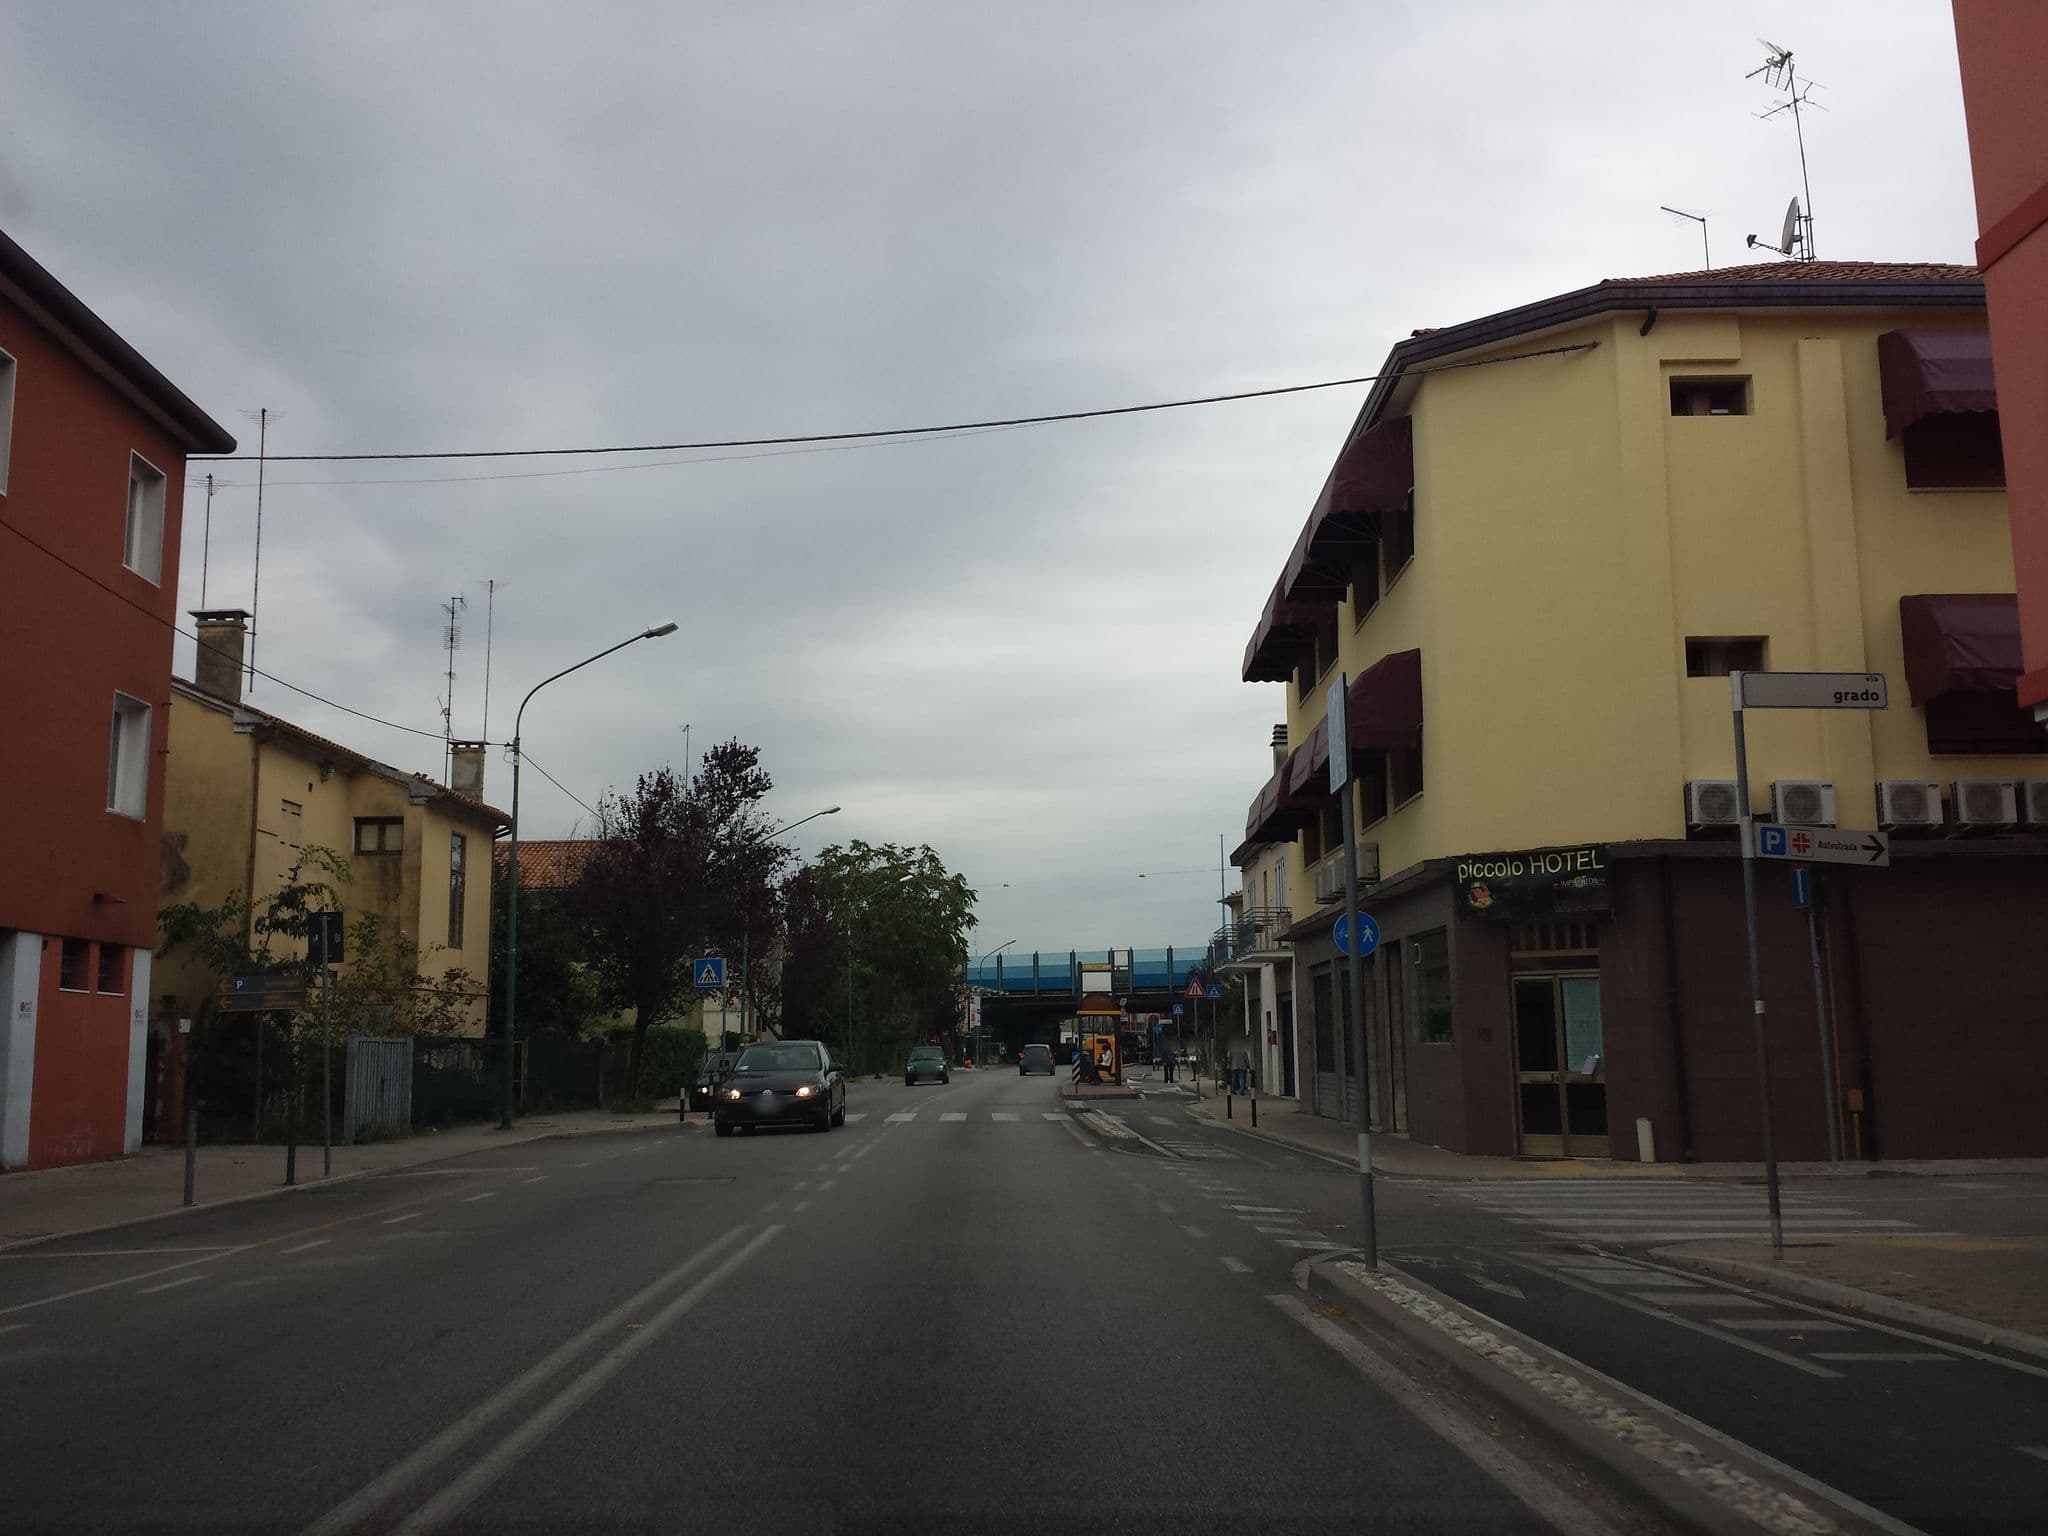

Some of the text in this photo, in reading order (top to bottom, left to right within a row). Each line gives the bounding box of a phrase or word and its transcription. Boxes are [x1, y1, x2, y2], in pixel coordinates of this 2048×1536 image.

[1866, 675, 1879, 683] via
[1833, 689, 1880, 704] grado
[1766, 831, 1858, 852] P Autostrada
[1457, 858, 1524, 883] piccolo
[1530, 850, 1604, 875] HOTEL
[236, 980, 243, 990] P
